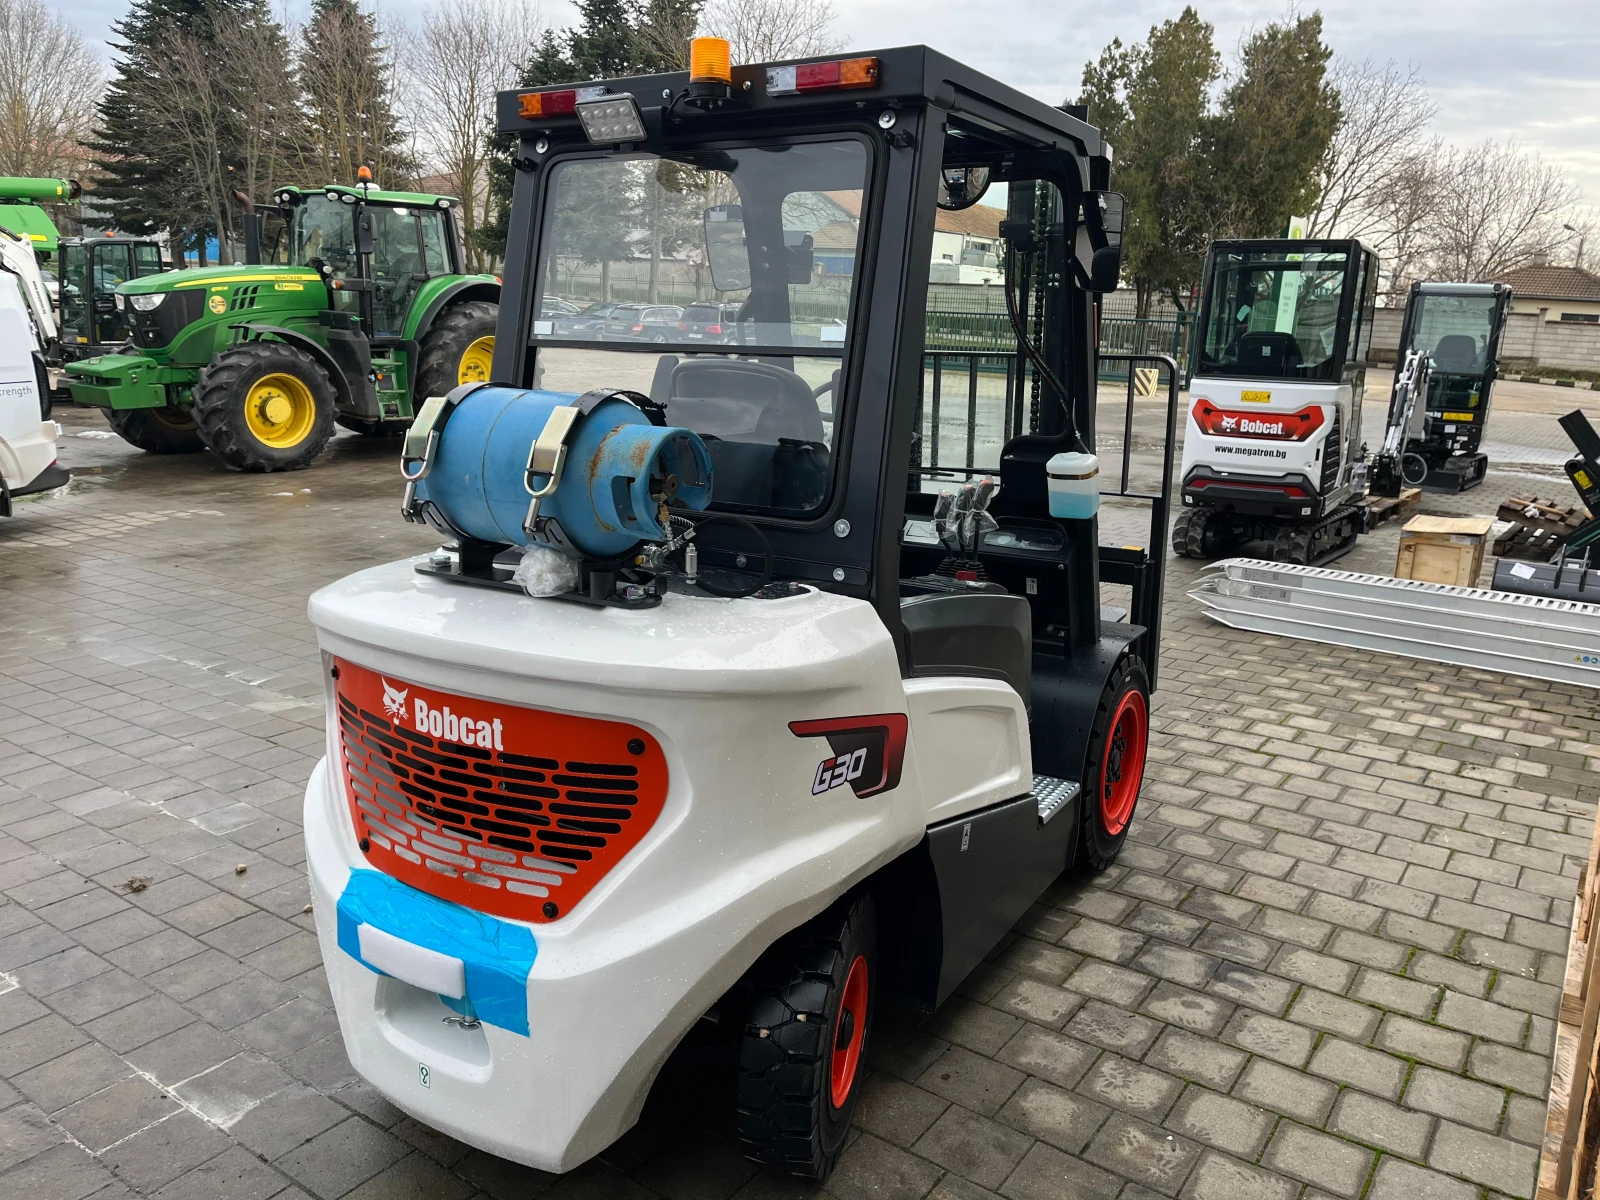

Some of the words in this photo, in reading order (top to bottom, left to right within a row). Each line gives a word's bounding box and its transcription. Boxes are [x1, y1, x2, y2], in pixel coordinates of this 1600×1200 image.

[1240, 418, 1284, 435] Bobcat
[1214, 444, 1287, 459] www.megatron.bg
[414, 697, 504, 752] Bobcat
[812, 746, 867, 797] G30
